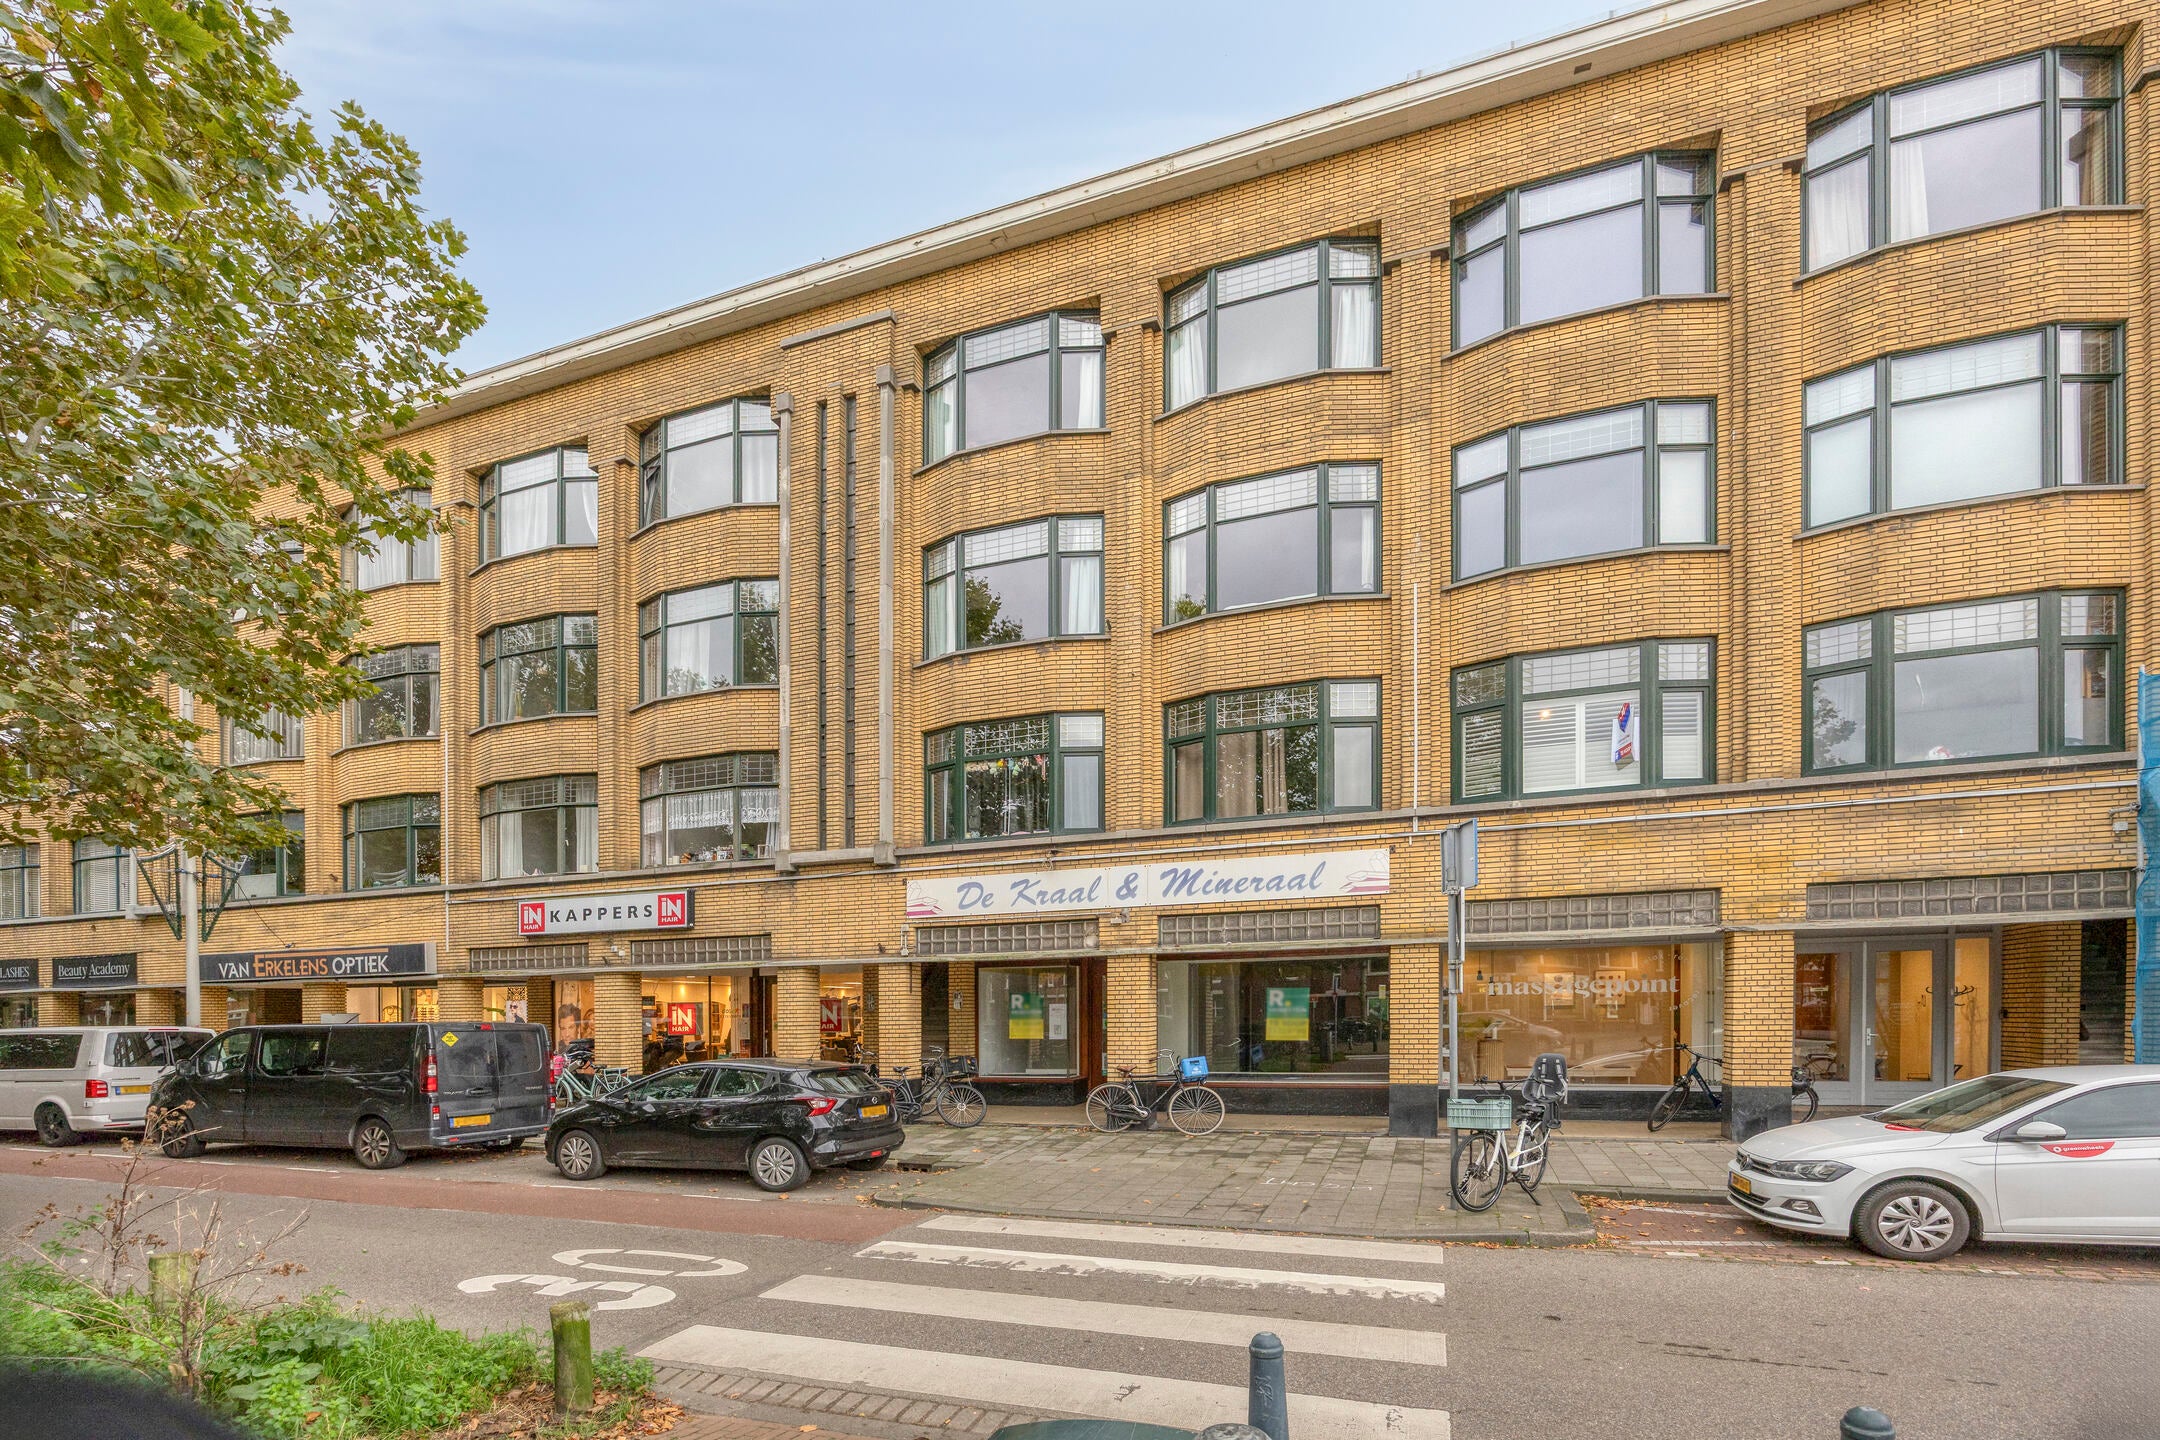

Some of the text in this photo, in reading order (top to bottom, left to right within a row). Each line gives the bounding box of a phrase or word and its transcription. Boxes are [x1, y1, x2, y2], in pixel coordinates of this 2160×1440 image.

[956, 860, 1328, 911] De Kraal & Mineraal
[549, 904, 653, 923] KAPPERS
[57, 962, 130, 979] Beauty Academy
[218, 954, 389, 979] VAN ERKELENS OPTIEK
[1488, 973, 1681, 998] massagepoint
